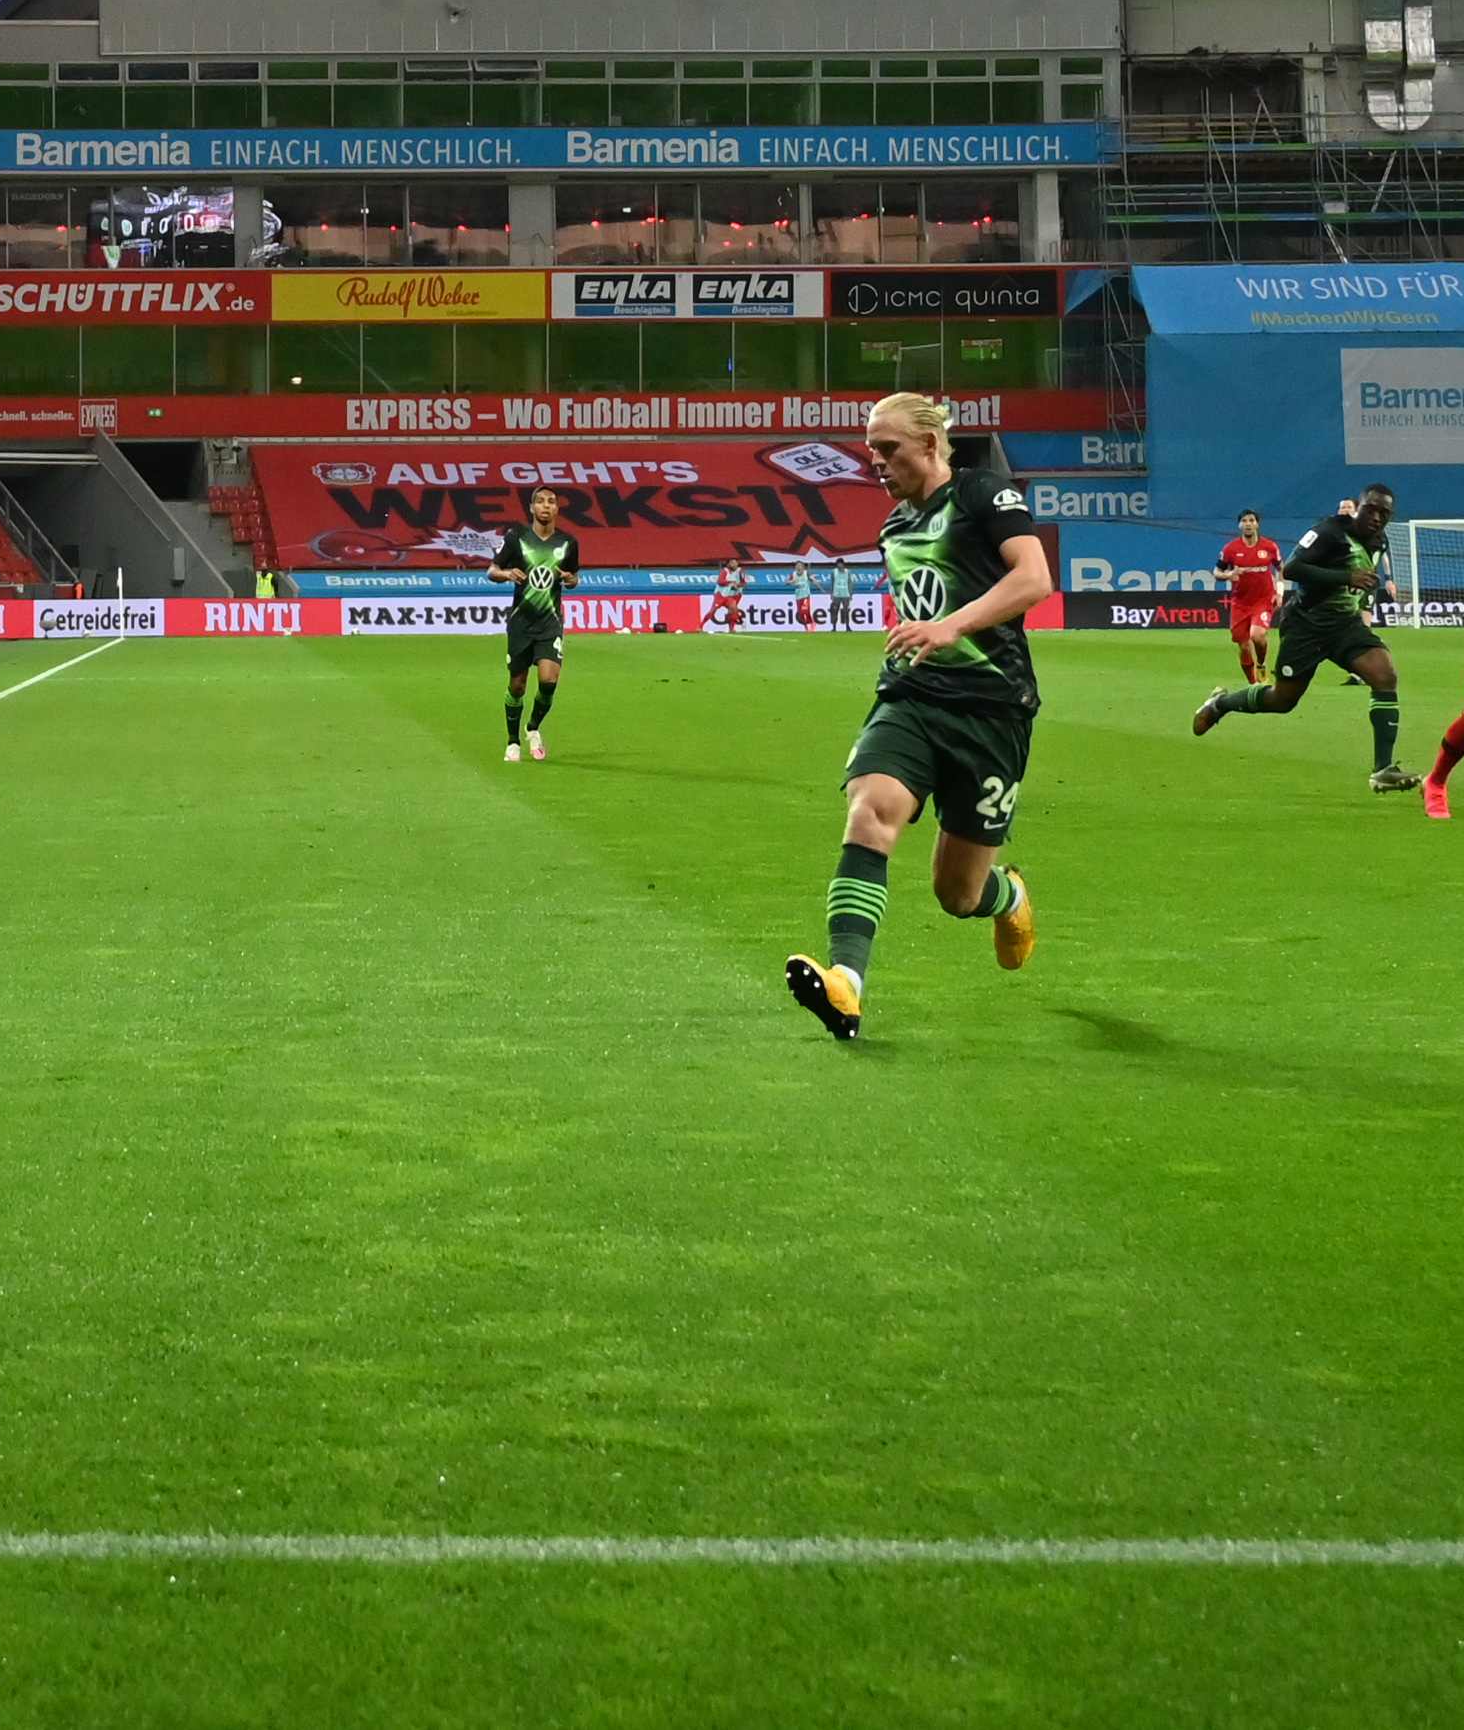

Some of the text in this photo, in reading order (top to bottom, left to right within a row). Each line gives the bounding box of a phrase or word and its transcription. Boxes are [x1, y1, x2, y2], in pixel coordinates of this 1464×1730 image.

[16, 132, 521, 167] Barmenia EINFACH. MENSCHLICH.
[566, 130, 1070, 164] Barmenia EINFACH. MENSCHLICH.
[336, 275, 480, 318] Rudolf Weber
[580, 274, 671, 305] EMKA
[698, 274, 789, 305] EMKA
[1236, 277, 1303, 300] WIR
[1310, 276, 1387, 300] SIND
[1398, 271, 1463, 298] FÜR
[955, 289, 1040, 313] quinta
[81, 405, 115, 428] EXPRESS
[346, 398, 471, 430] EXPRESS
[502, 400, 551, 429] Wo
[559, 398, 669, 428] Fußball
[678, 396, 776, 427] immer
[783, 396, 873, 427] Heims
[388, 462, 489, 485] AUF
[325, 575, 432, 587] Barmenia
[40, 606, 156, 632] Getreidefrei
[204, 602, 302, 632] RINTI
[349, 607, 513, 626] MAX-I-MUM
[563, 599, 660, 629] RINTI
[1111, 604, 1220, 627] BayArena
